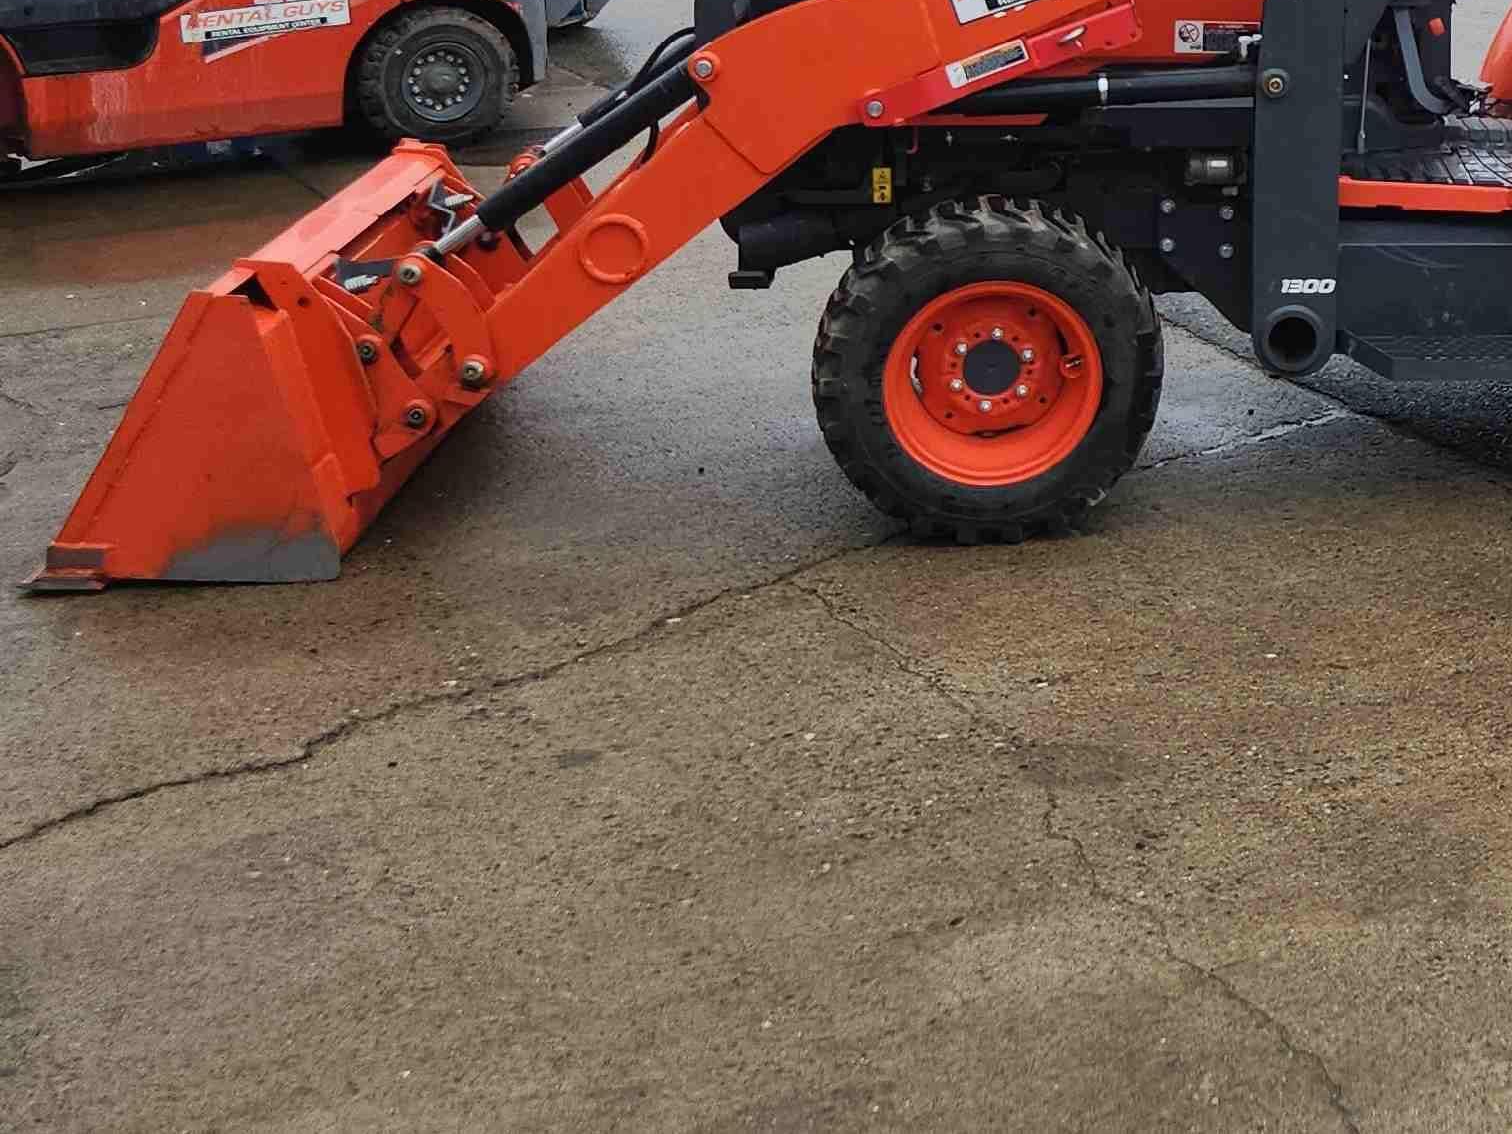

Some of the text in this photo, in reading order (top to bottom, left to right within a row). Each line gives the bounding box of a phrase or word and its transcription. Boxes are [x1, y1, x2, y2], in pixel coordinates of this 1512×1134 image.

[187, 0, 345, 30] RENTAL GUYS
[211, 28, 242, 38] RENTAL
[1281, 278, 1336, 294] 1300
